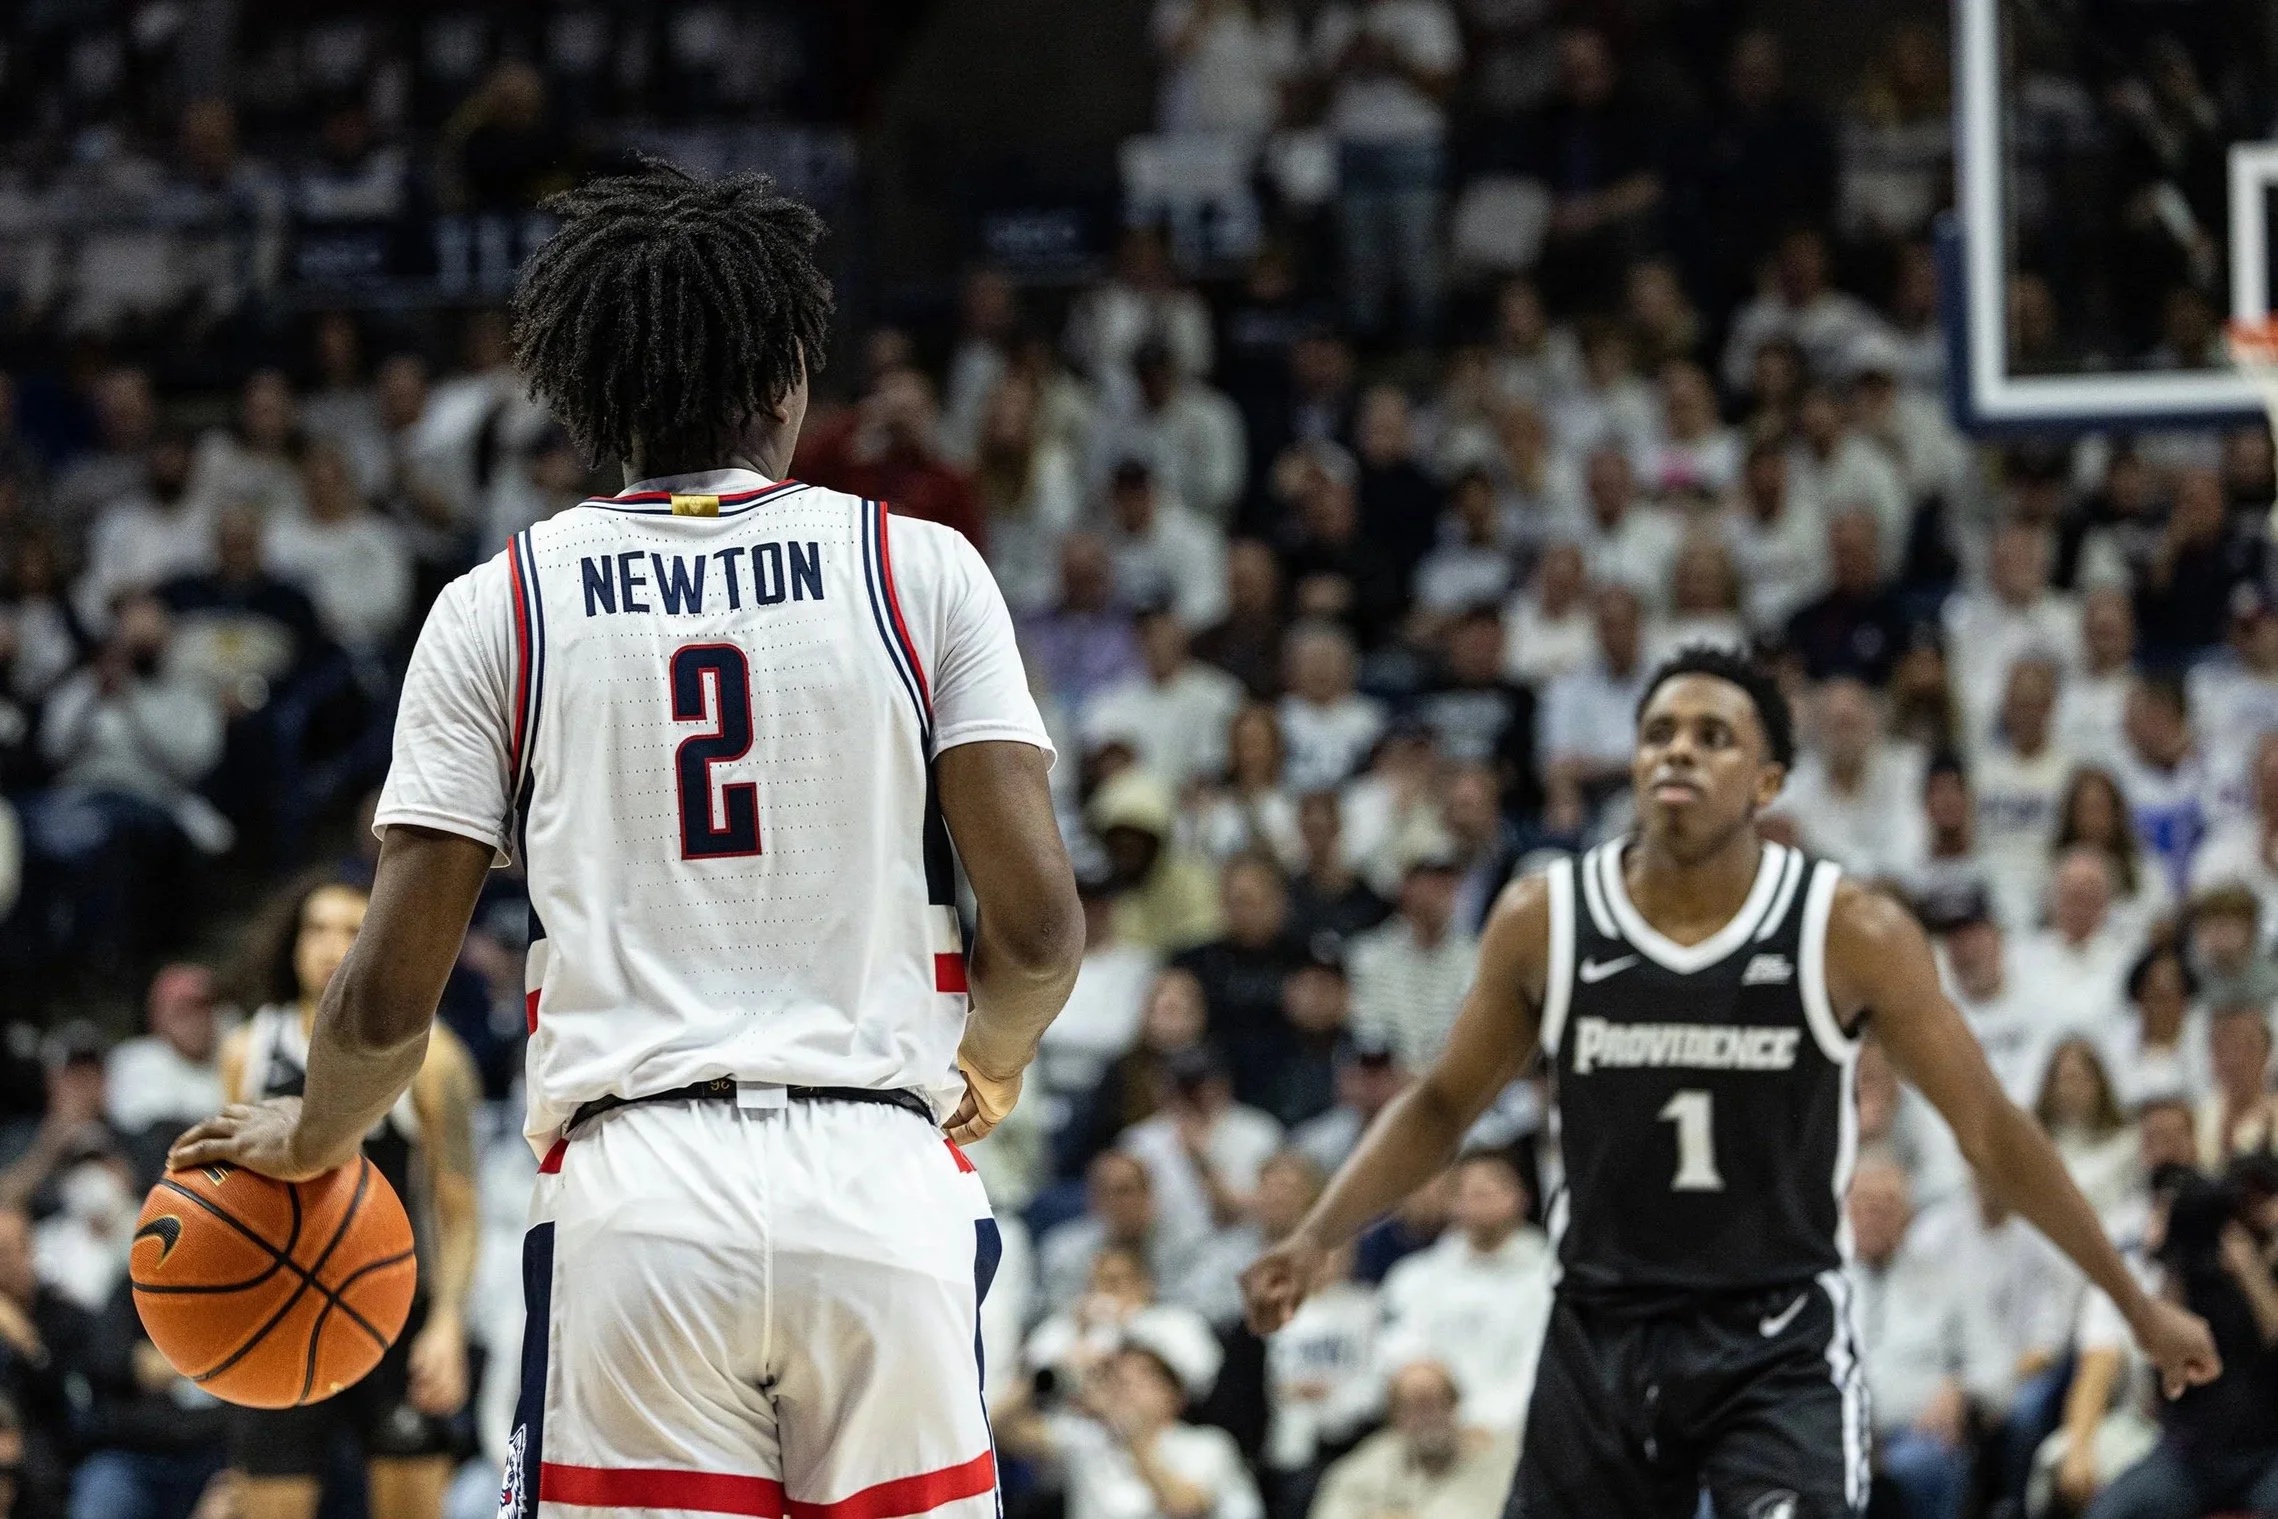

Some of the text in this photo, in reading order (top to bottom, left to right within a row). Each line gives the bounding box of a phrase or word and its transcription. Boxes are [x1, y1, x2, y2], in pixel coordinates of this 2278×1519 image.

[580, 541, 825, 617] NEWTON
[669, 642, 762, 861] 2
[1573, 1016, 1801, 1073] PROVIDENCE
[1657, 1088, 1726, 1192] 1
